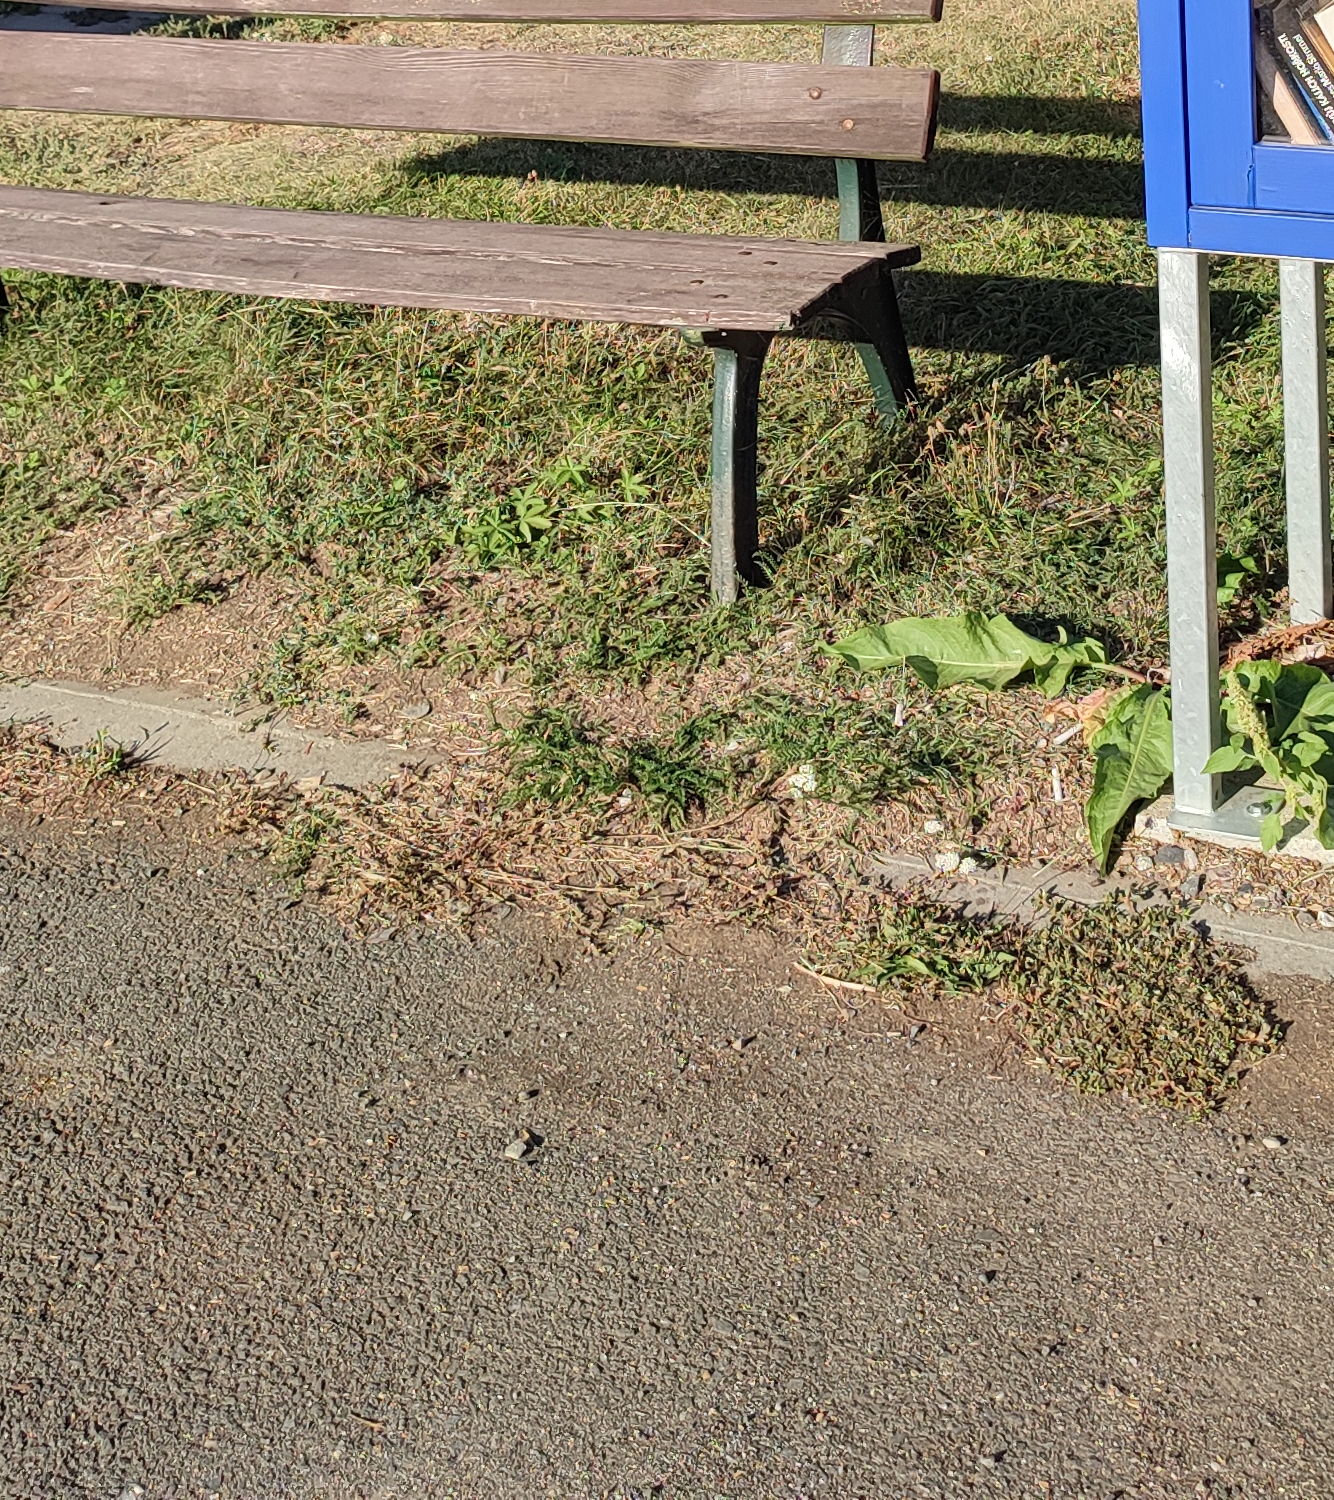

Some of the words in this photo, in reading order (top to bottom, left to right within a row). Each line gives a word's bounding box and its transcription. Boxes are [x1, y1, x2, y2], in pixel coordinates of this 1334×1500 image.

[1276, 31, 1310, 78] HOŘKOSTI
[1293, 32, 1316, 65] Simmel
[1303, 73, 1329, 107] KALICH
